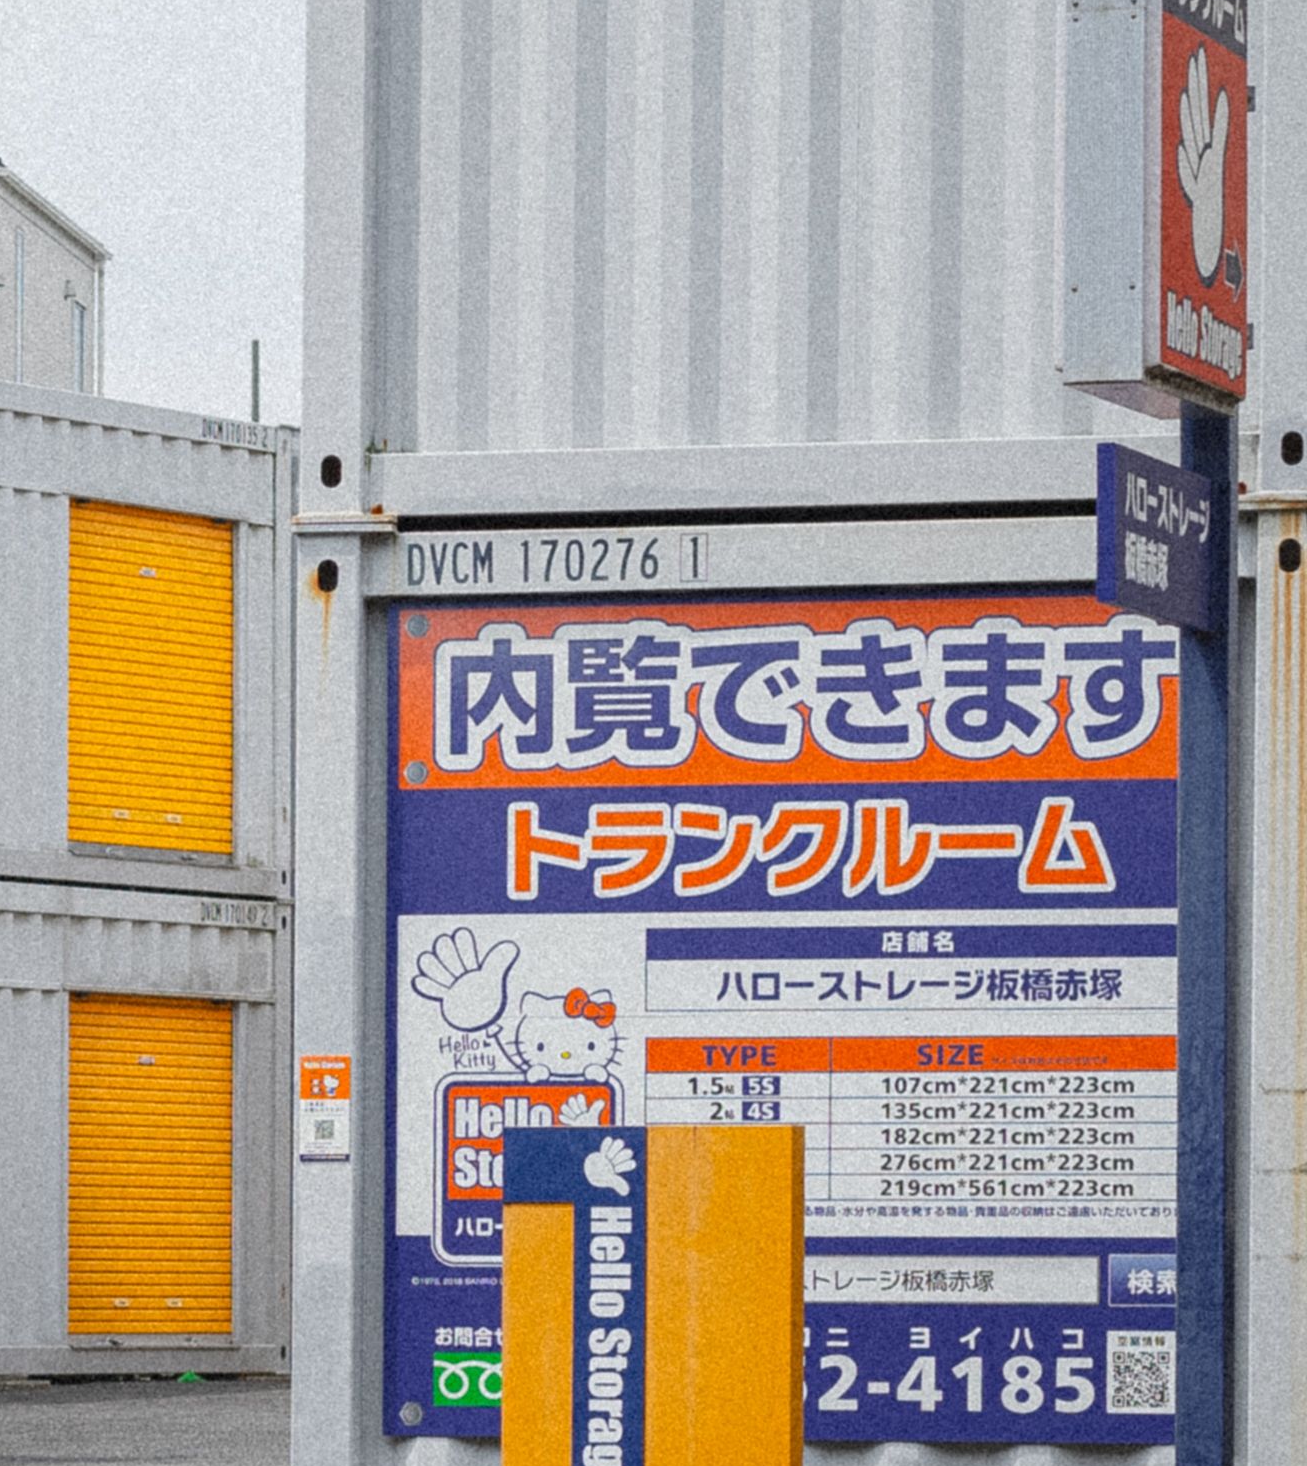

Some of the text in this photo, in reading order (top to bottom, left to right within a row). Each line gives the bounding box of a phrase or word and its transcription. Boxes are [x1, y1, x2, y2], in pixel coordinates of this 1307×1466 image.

[1167, 291, 1243, 381] Hello Storage
[1125, 472, 1210, 544] ハローストレージ
[407, 541, 494, 587] DVCM
[521, 538, 660, 583] 170276
[441, 622, 1177, 764] 内覧できます
[509, 799, 1115, 897] トランクルーム
[881, 931, 955, 954] 店舗名
[716, 968, 1123, 1002] ハローストレージ板橋赤塚
[439, 1037, 480, 1054] Hello
[702, 1045, 777, 1067] TYPE
[917, 1044, 984, 1066] SIZE
[453, 1052, 496, 1071] Kitty
[748, 1077, 775, 1095] 5S
[747, 1102, 775, 1120] 4S
[588, 1206, 632, 1318] Hello
[804, 1269, 994, 1293] トレージ板橋赤塚
[803, 1354, 1096, 1414] 2-4185
